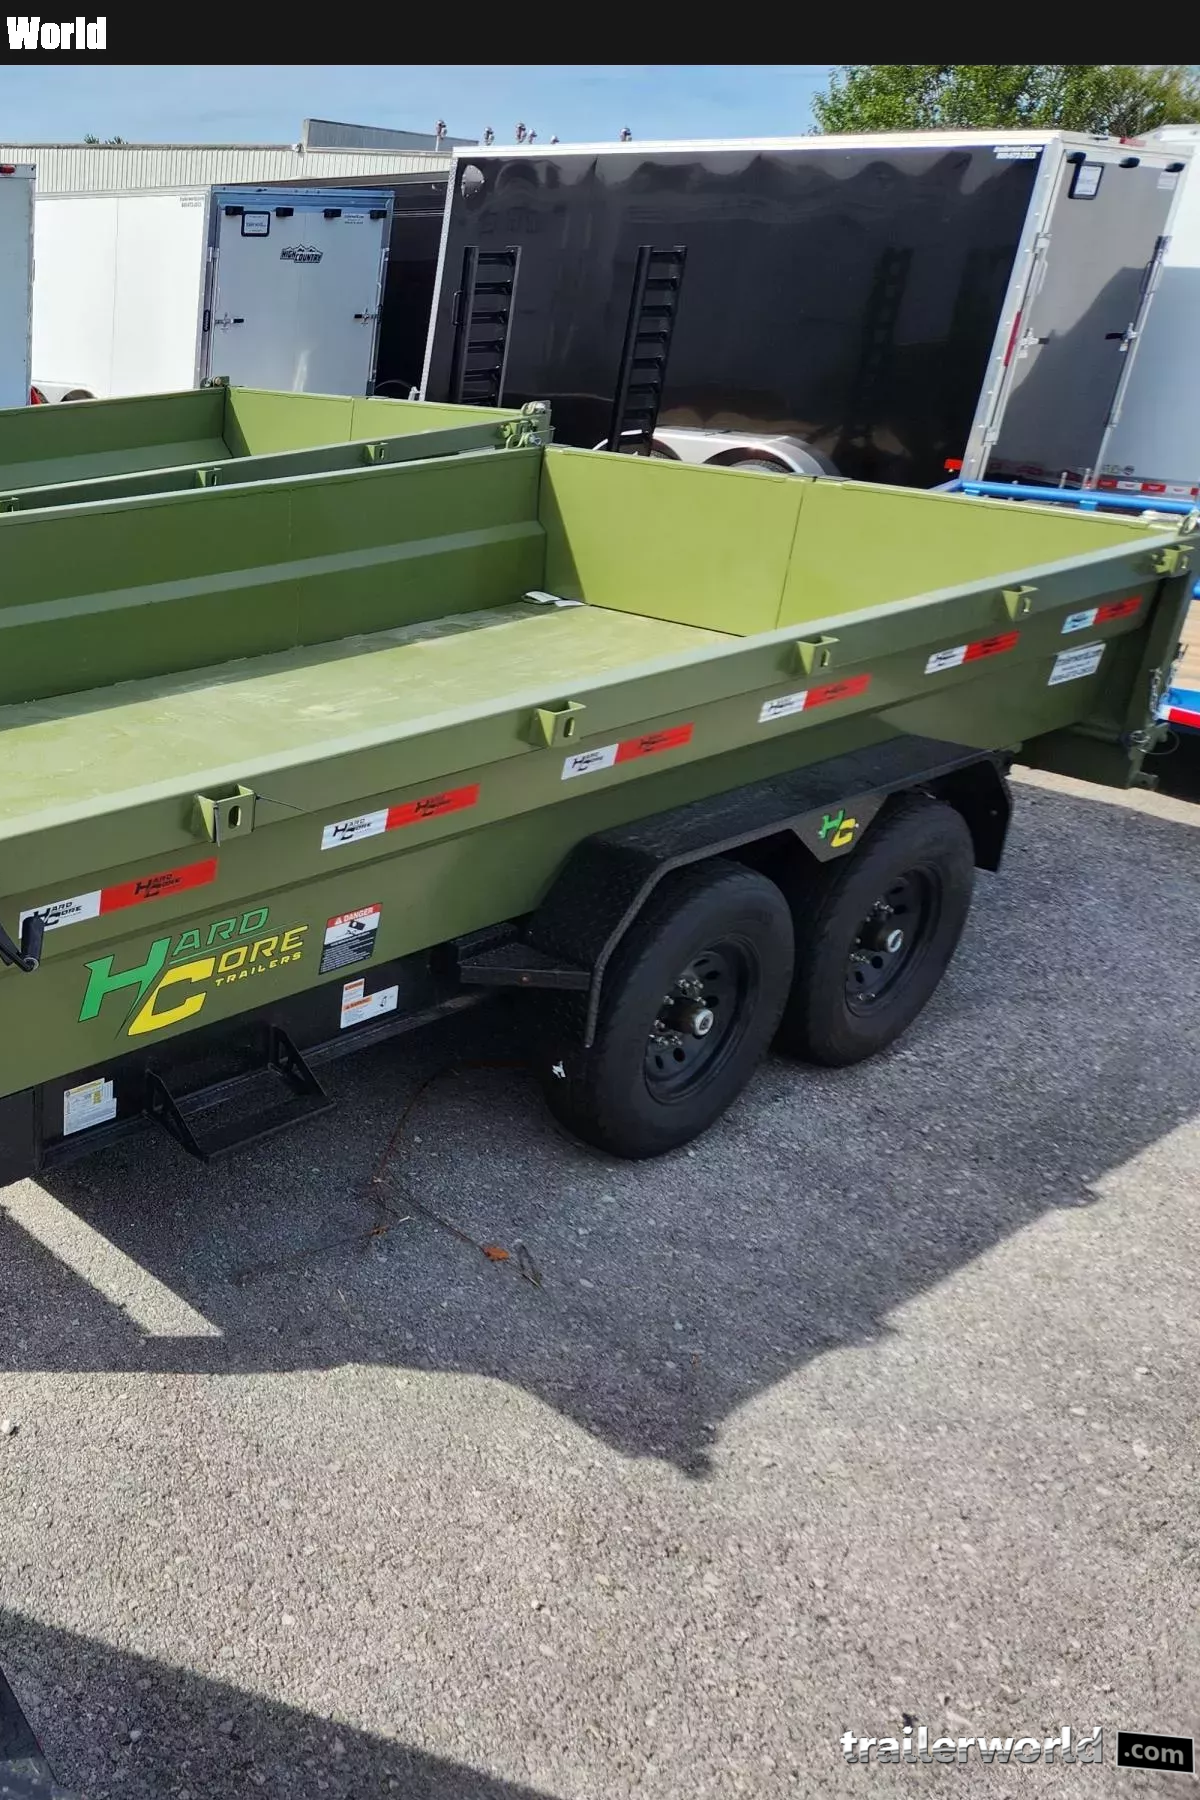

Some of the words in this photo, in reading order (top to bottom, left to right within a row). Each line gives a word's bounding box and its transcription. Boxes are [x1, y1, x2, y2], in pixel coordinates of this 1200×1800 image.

[343, 907, 374, 922] DANGER
[78, 906, 269, 1028] HARD
[128, 925, 309, 1036] CORE
[215, 951, 302, 987] TRAILERS
